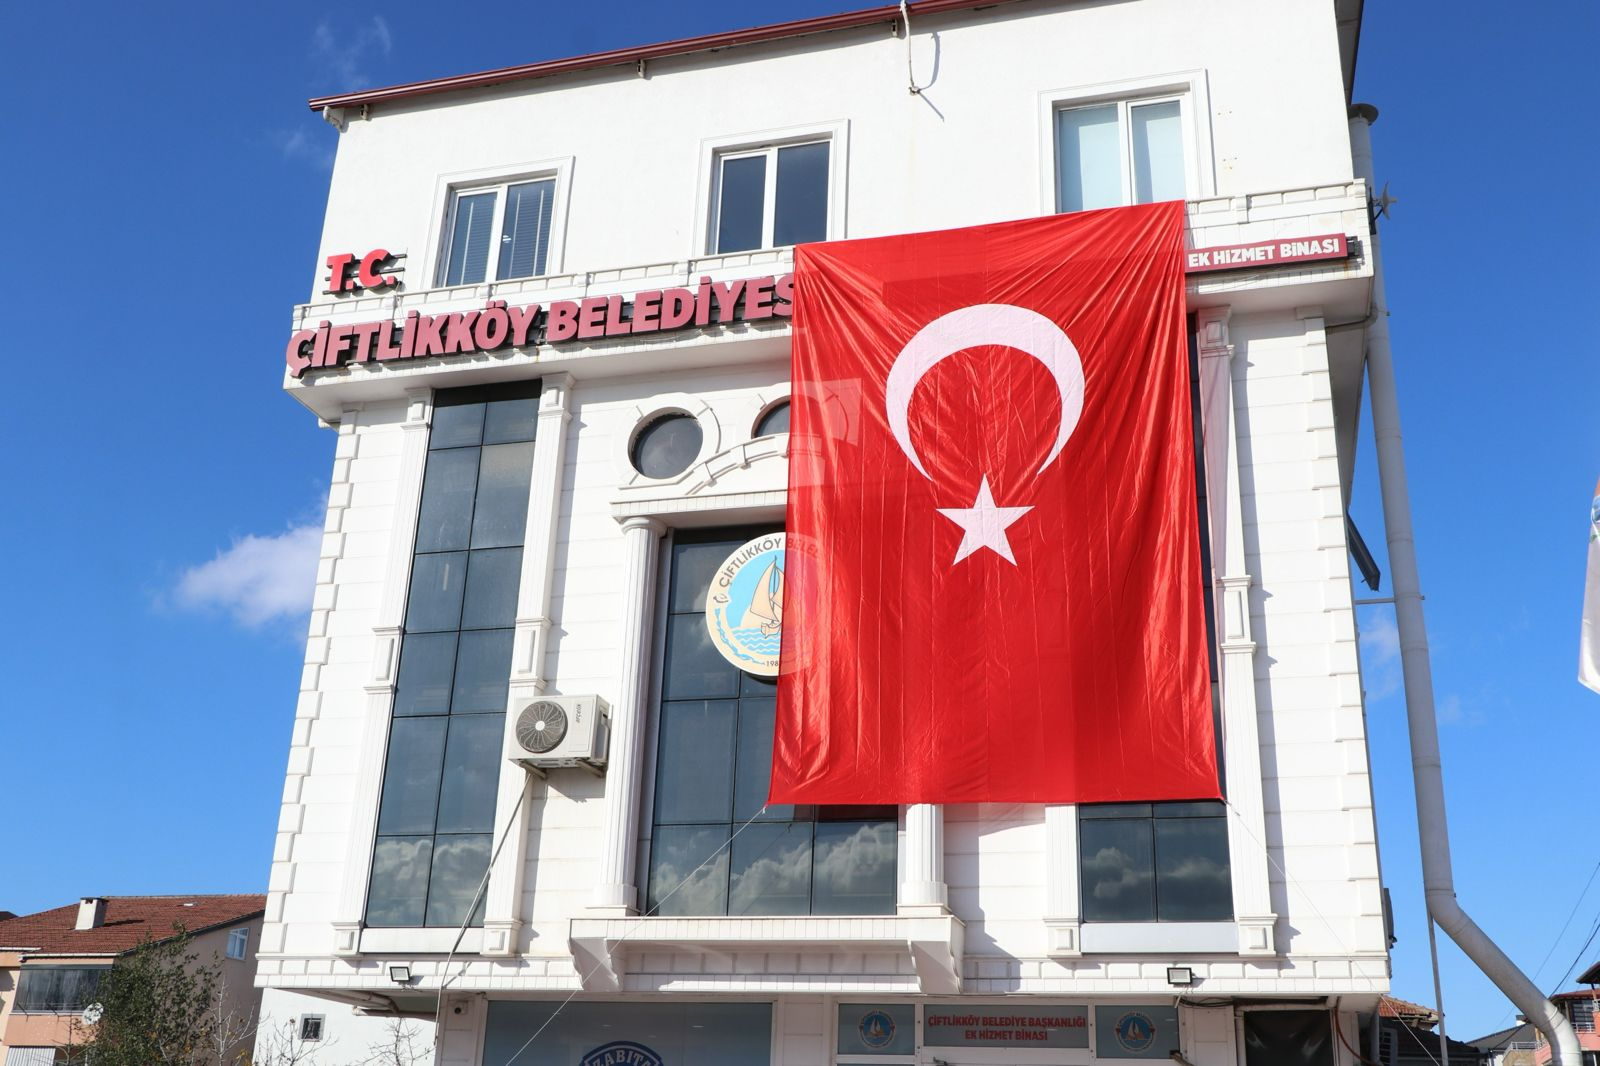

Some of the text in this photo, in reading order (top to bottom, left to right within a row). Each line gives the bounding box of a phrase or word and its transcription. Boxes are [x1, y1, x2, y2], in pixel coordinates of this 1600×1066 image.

[327, 248, 399, 292] T.C.
[1188, 251, 1211, 268] EK
[286, 272, 795, 377] ÇİFTLİKKÖY BELEDİYES
[718, 537, 782, 588] ÇİFTLİKKÖY
[928, 1014, 1086, 1029] ÇİFTLİKKÖY BELEDİYE BAŞKANLIĞI
[965, 1028, 1048, 1041] EK HİZMET BİNASI
